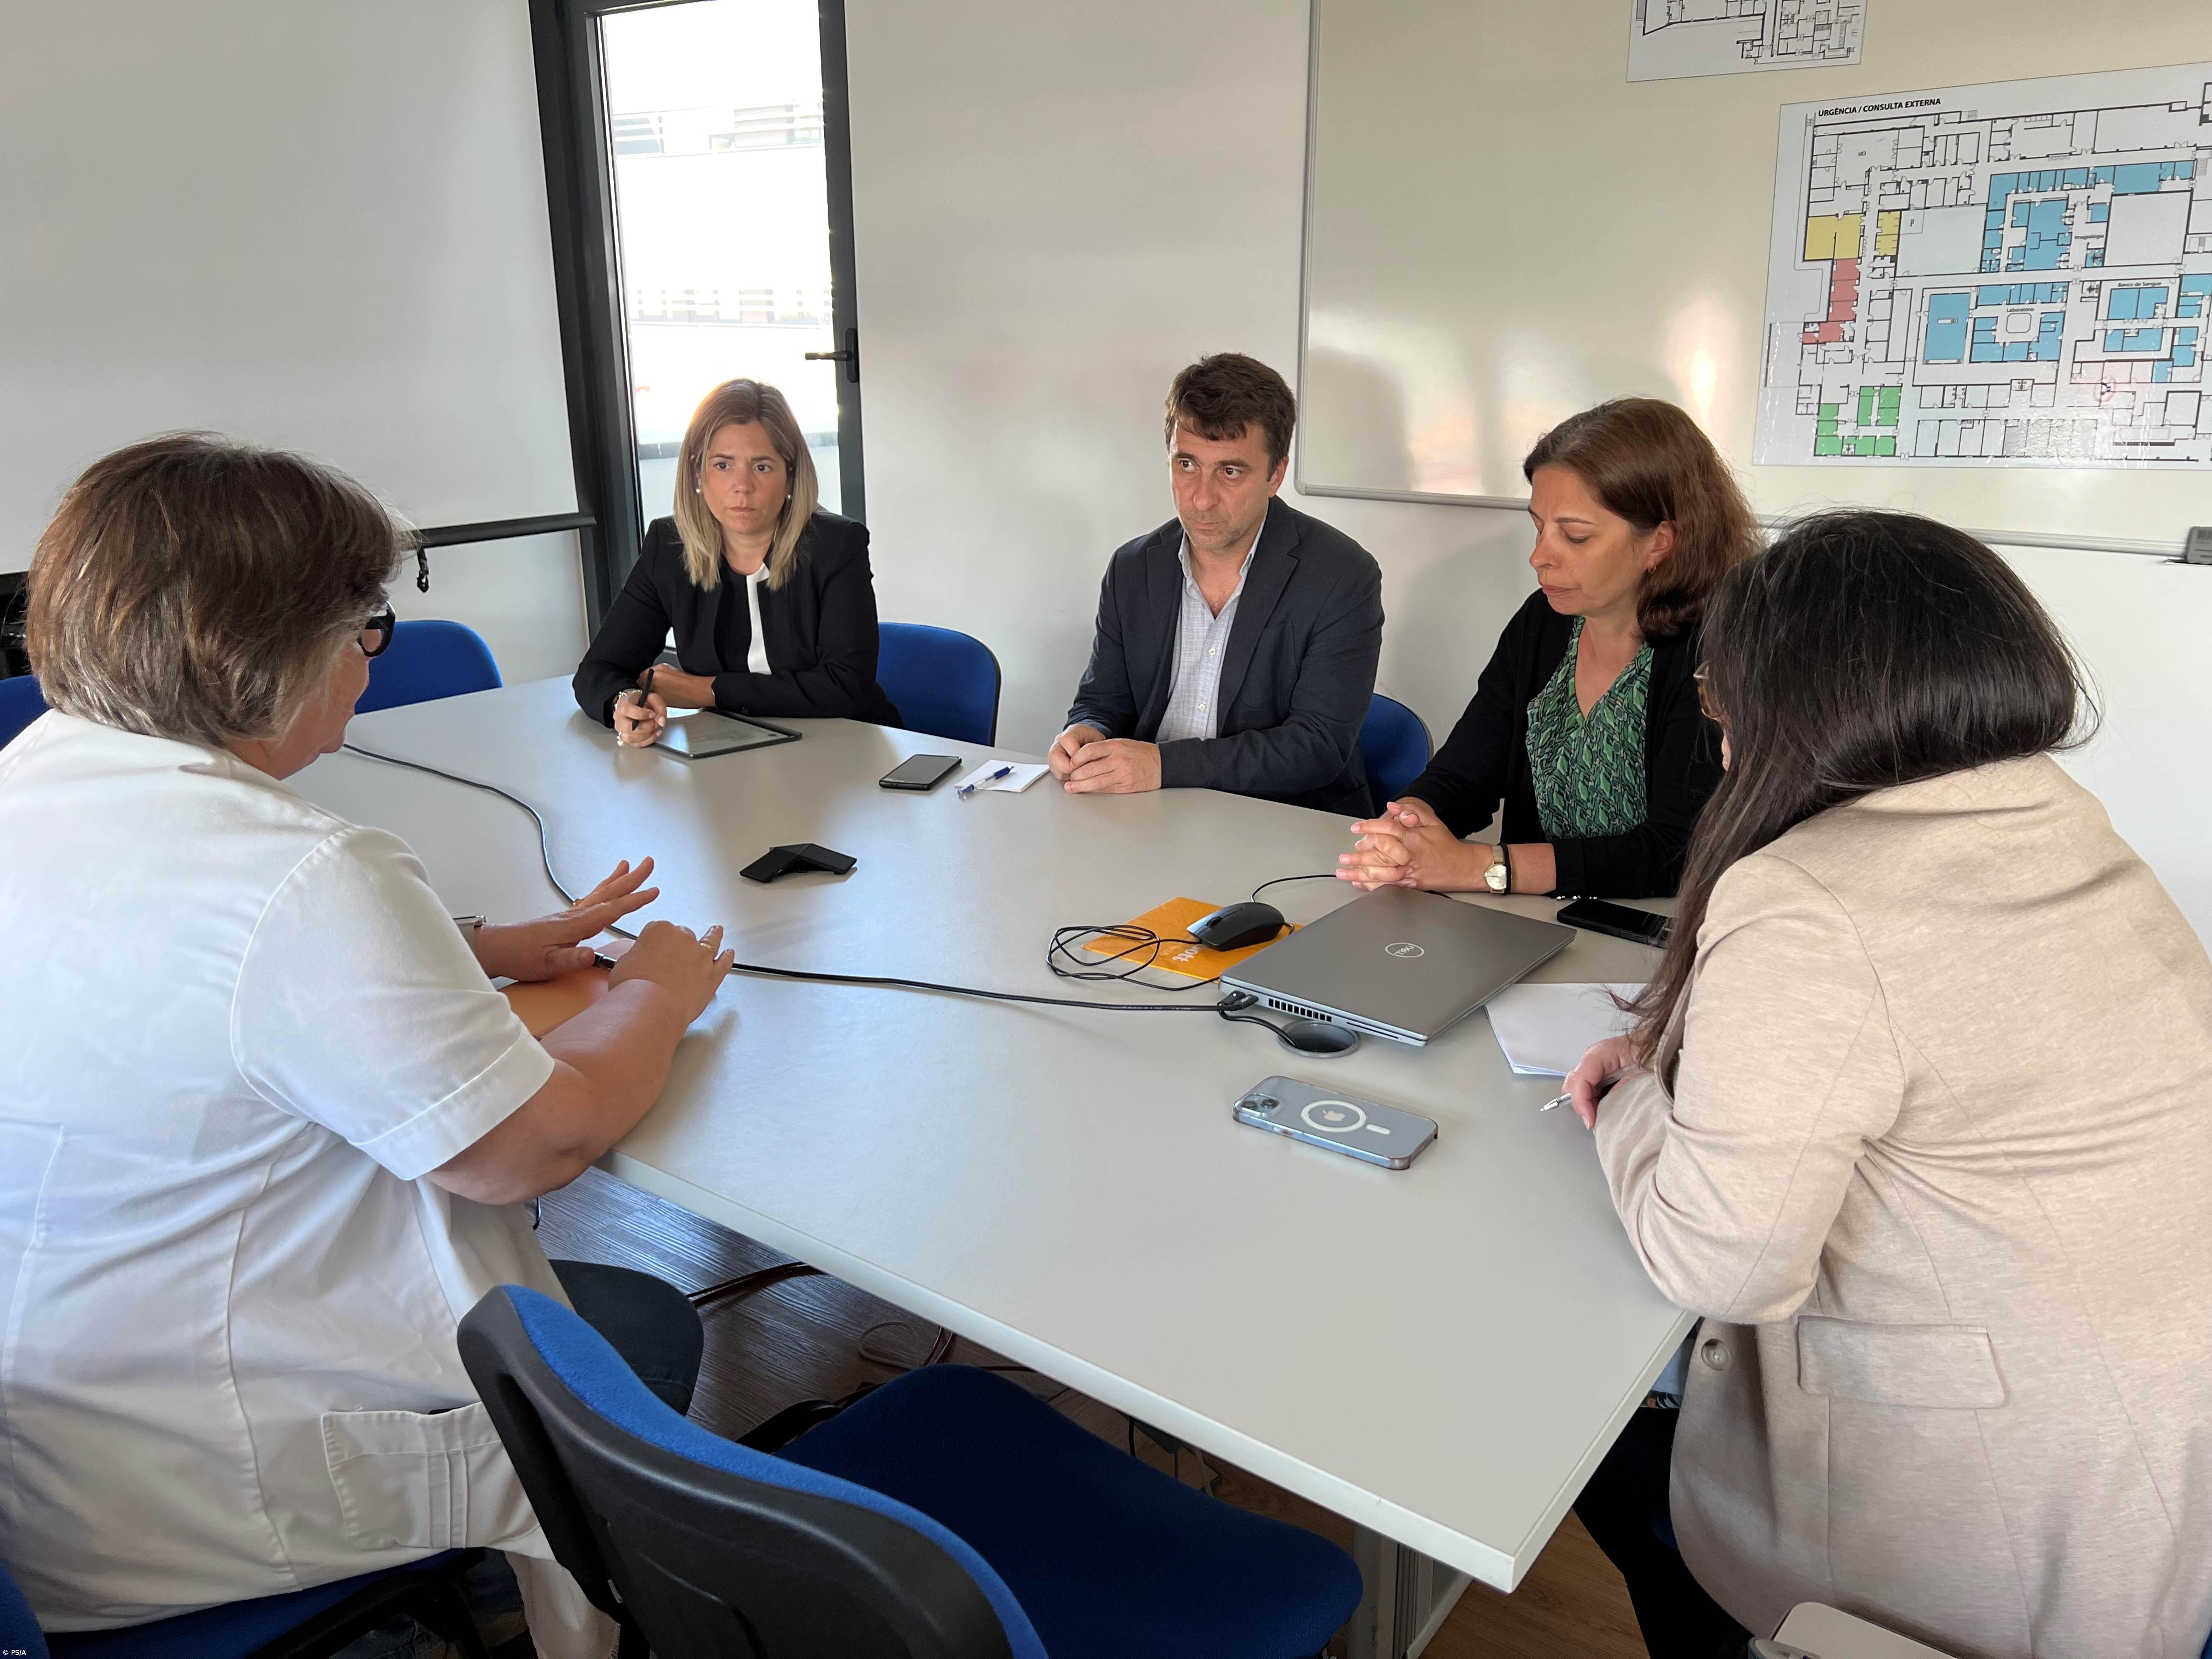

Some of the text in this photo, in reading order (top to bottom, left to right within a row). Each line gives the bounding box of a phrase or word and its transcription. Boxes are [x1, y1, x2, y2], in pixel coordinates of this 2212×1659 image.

[1818, 106, 1857, 117] URGÊNCIA
[1863, 102, 1903, 112] CONSULTA
[1905, 98, 1941, 108] EXTERNA
